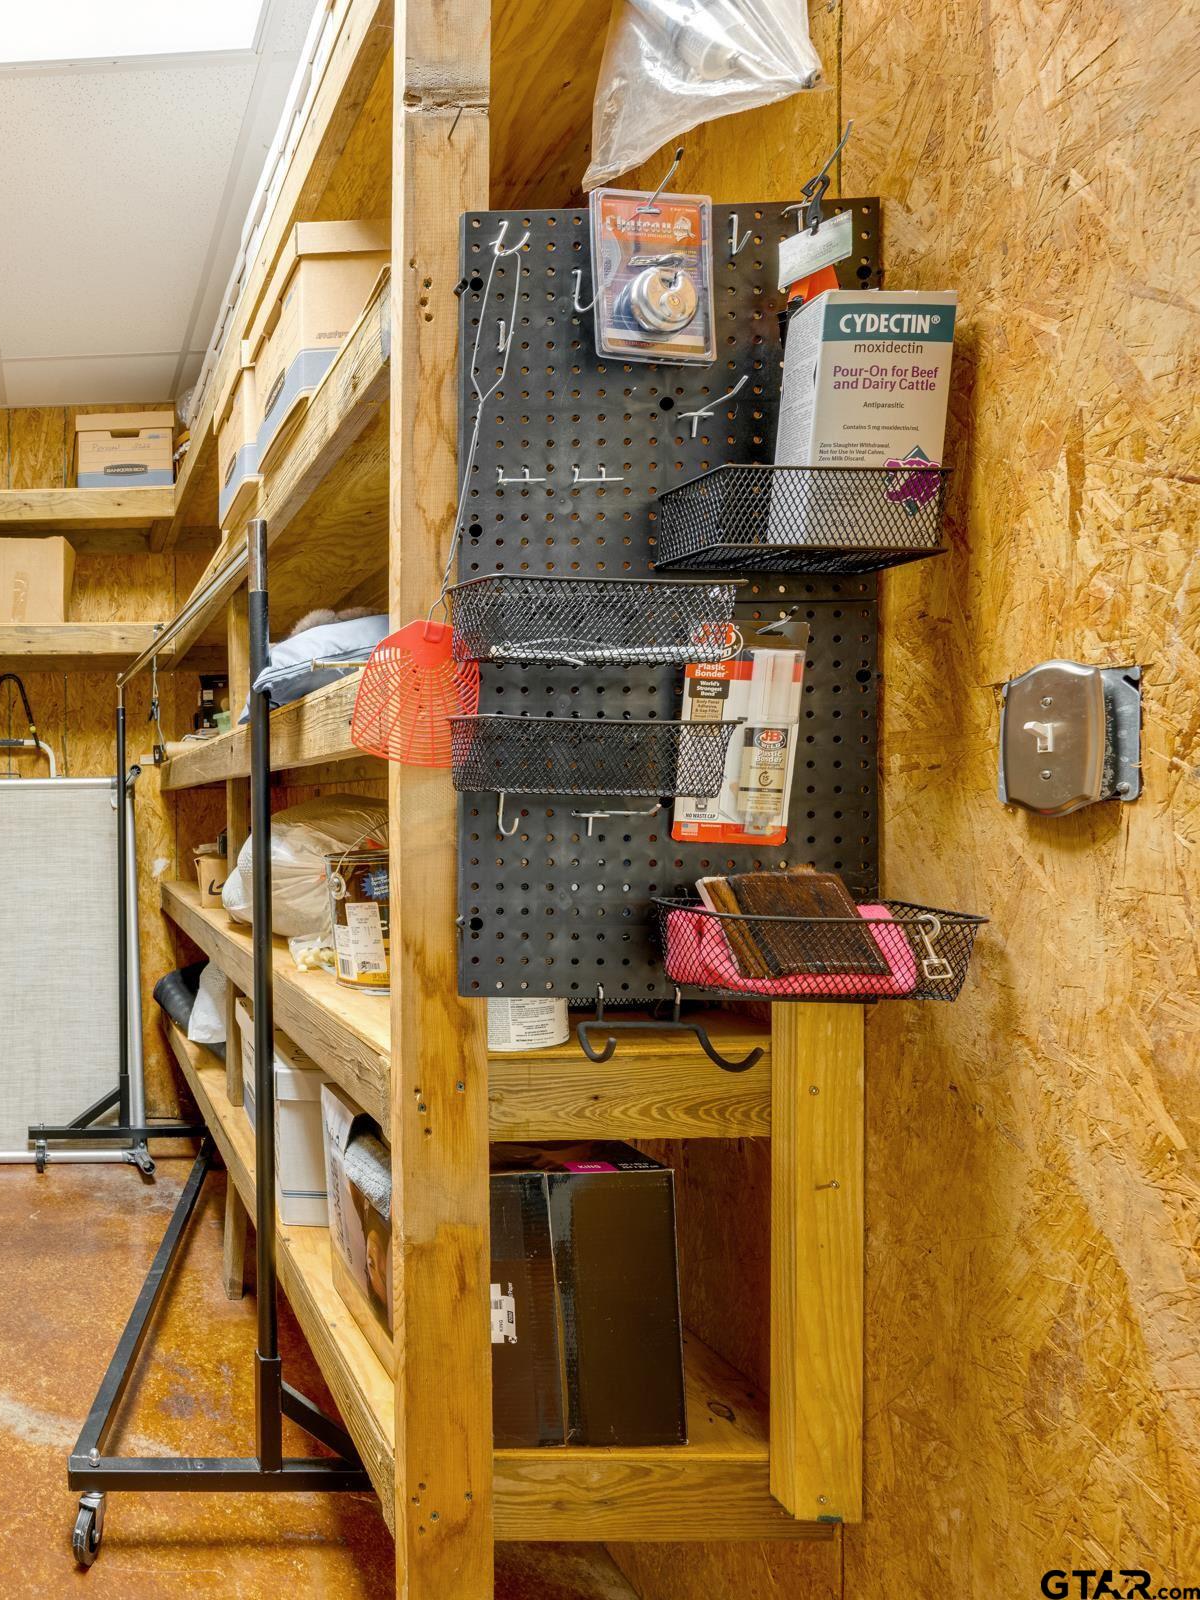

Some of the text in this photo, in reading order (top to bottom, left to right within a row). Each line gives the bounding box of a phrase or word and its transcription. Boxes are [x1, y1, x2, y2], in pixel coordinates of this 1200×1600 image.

[853, 341, 924, 354] moxidectin
[833, 365, 940, 378] Pour-On for Beef
[833, 378, 936, 392] and Dairy Cattle
[862, 401, 905, 409] Antiparasitic
[698, 663, 726, 671] Plastic
